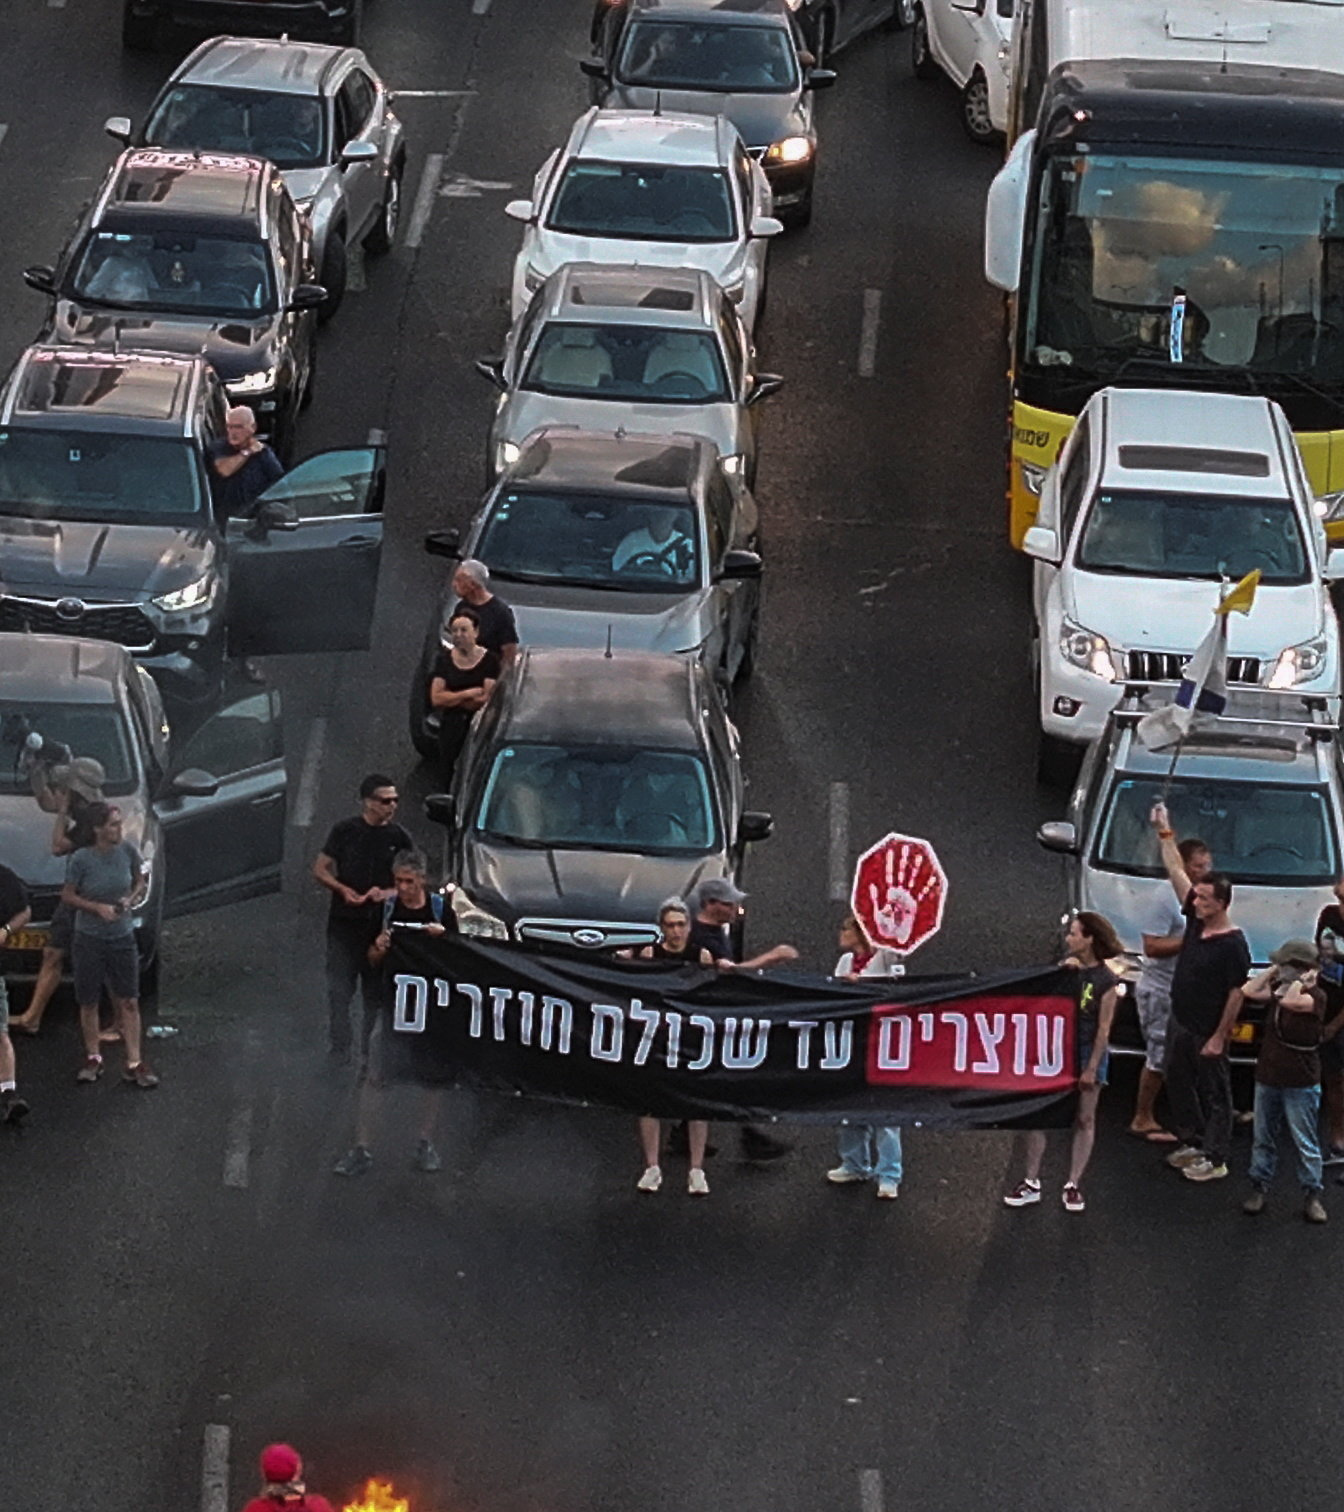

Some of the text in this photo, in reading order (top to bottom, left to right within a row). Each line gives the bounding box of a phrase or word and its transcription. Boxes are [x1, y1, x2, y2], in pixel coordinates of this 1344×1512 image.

[393, 973, 1065, 1077] עוצרים עד שכולם חוזרים
